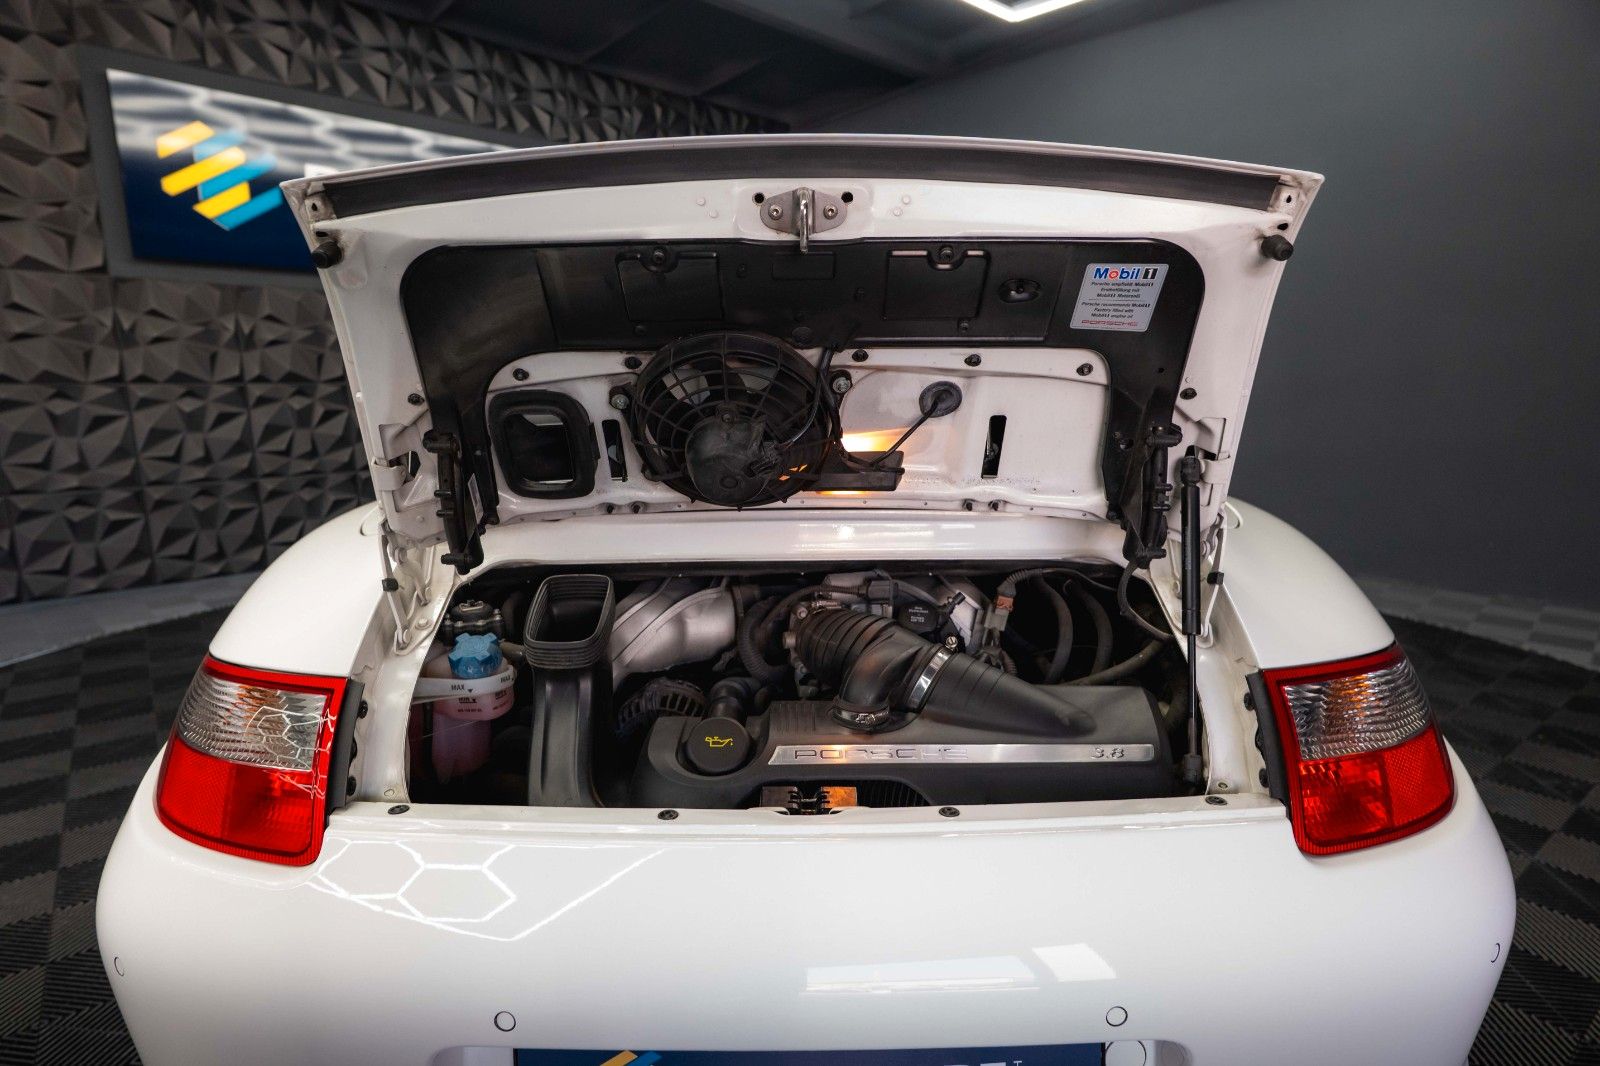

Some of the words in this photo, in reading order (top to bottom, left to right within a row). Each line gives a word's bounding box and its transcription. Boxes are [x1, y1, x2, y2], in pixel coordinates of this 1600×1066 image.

[1094, 268, 1140, 280] Mobil
[1144, 268, 1157, 280] 1
[794, 749, 968, 760] PORSCHE
[1091, 746, 1125, 759] 3.8
